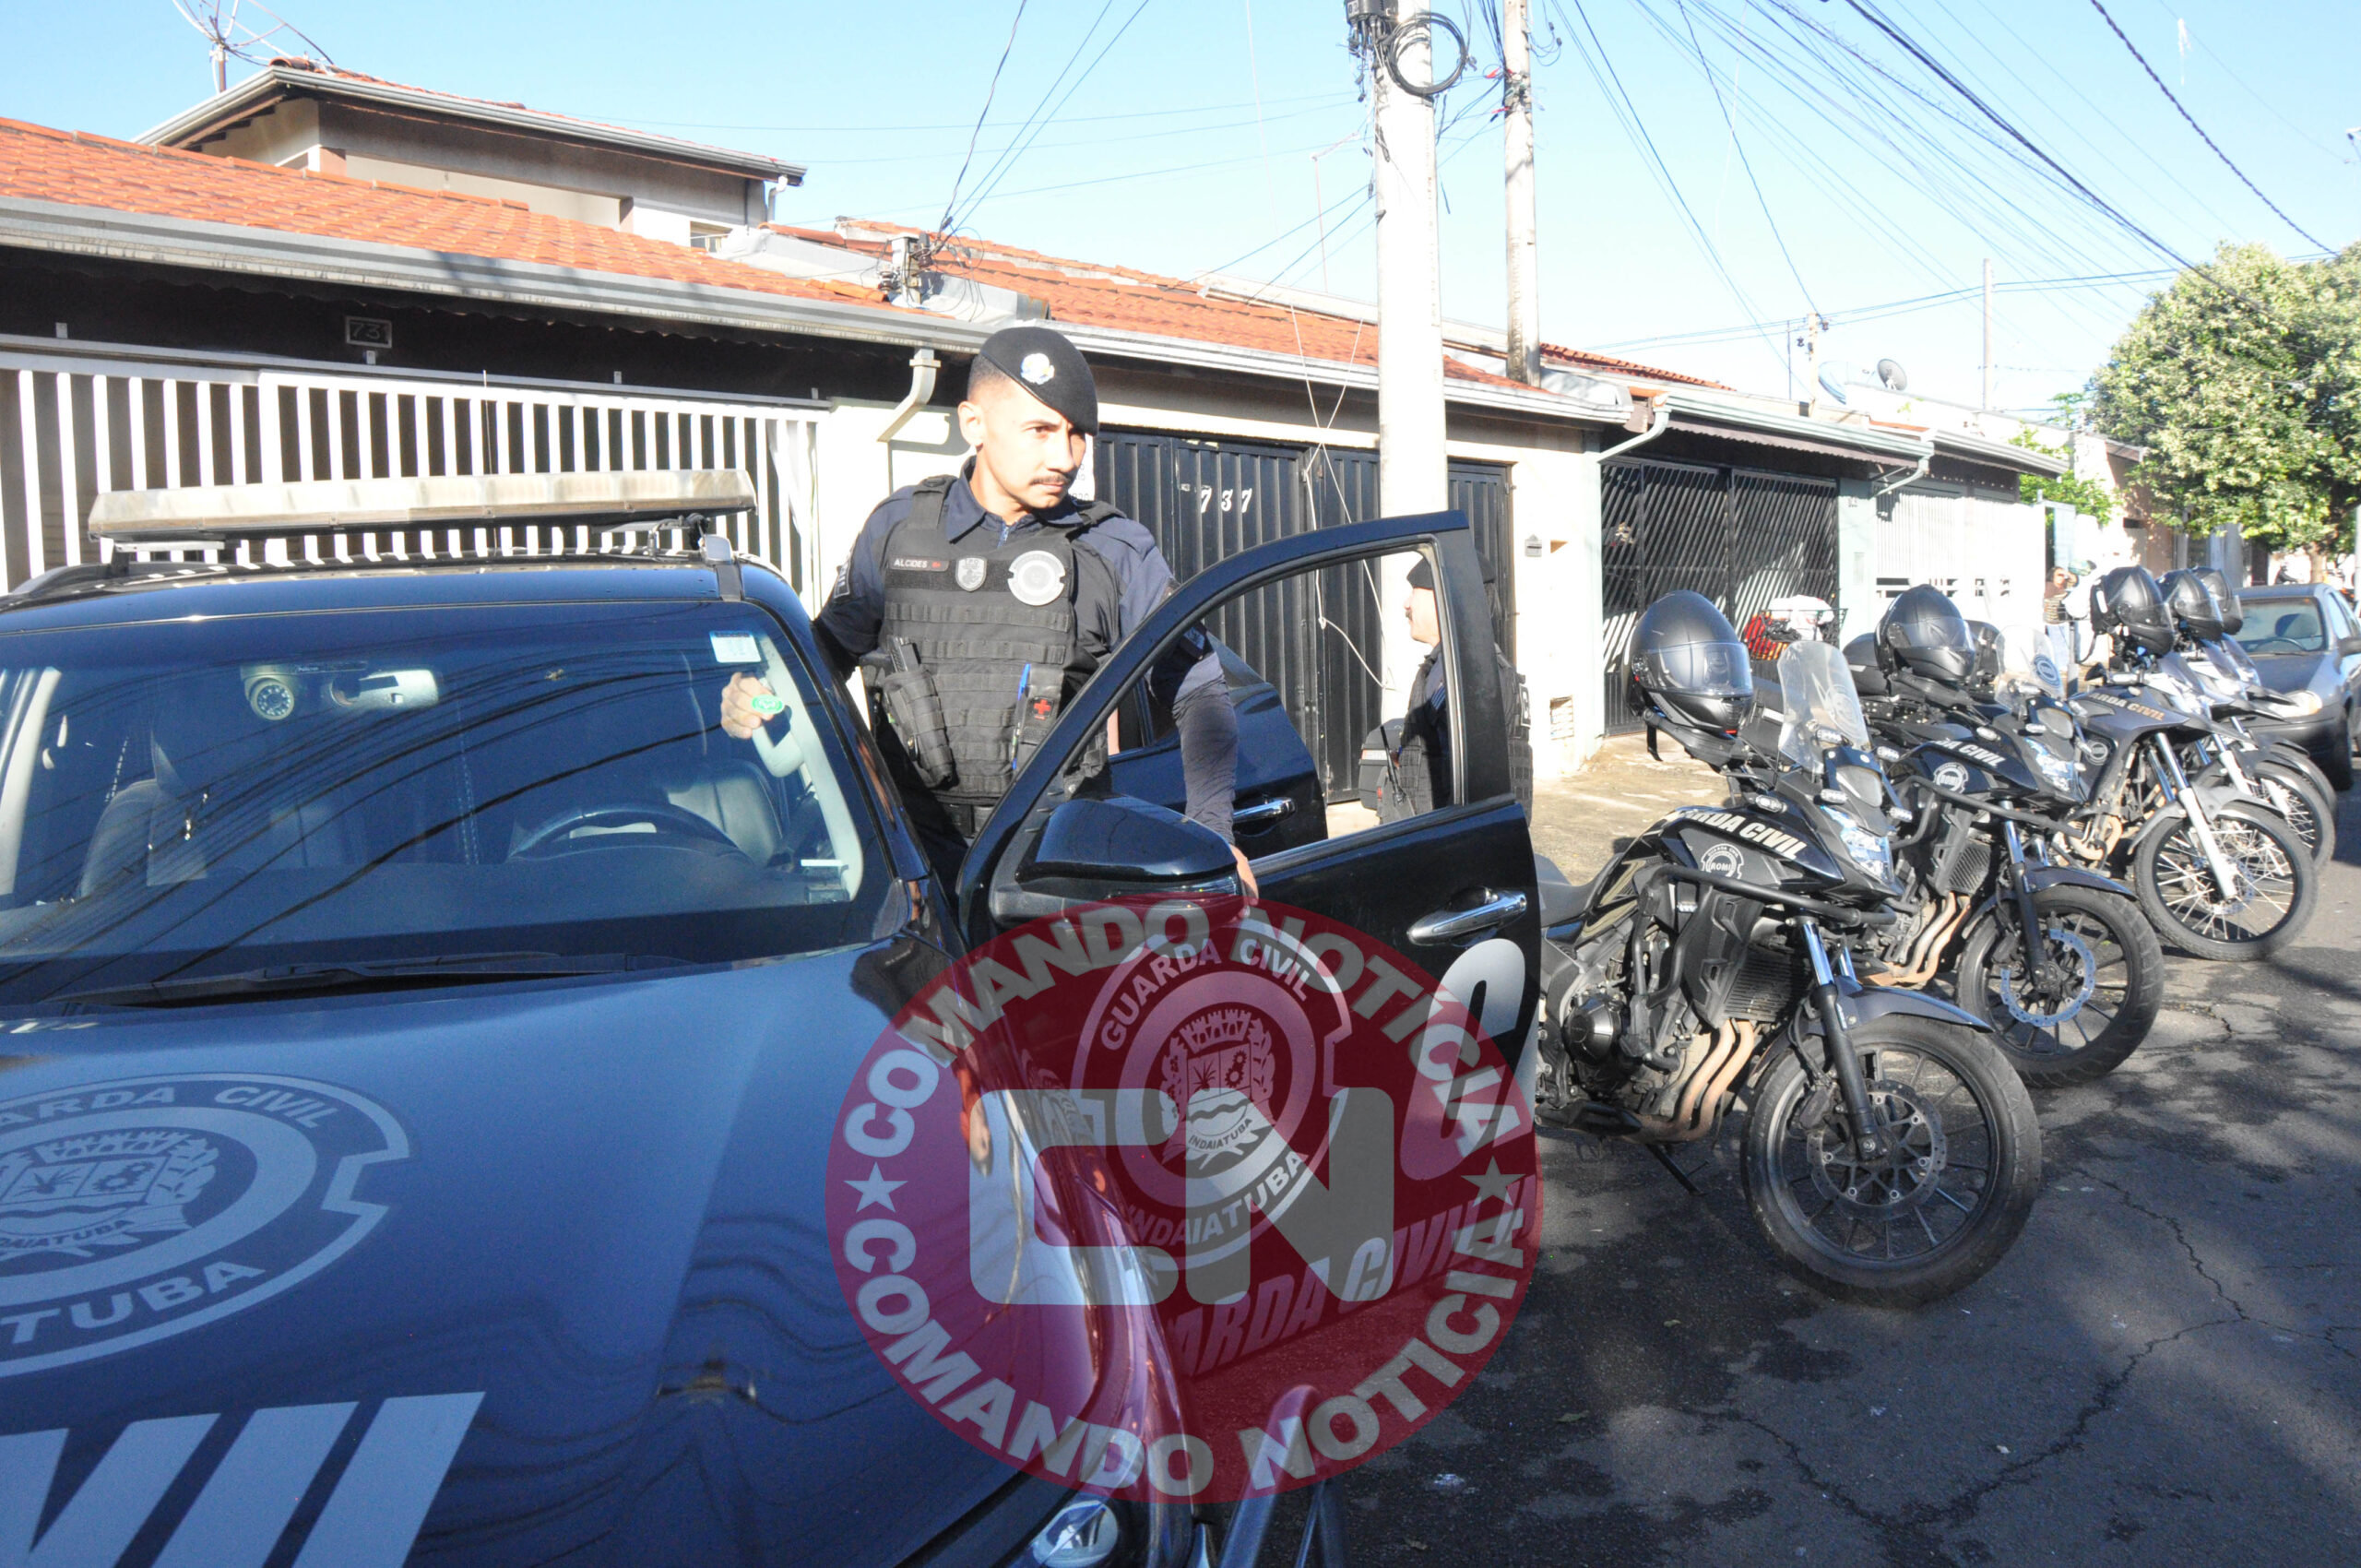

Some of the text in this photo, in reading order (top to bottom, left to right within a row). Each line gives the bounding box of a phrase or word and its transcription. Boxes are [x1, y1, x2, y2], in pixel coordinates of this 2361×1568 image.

[1201, 488, 1252, 513] 737
[894, 559, 928, 568] ALCIDES
[1959, 744, 2006, 766] CIVIL
[1739, 822, 1807, 860] CIVIL
[1100, 938, 1311, 1051] GUARDA CIVIL
[215, 1086, 338, 1128] CIVIL
[1188, 1117, 1253, 1150] INDAIATUBA
